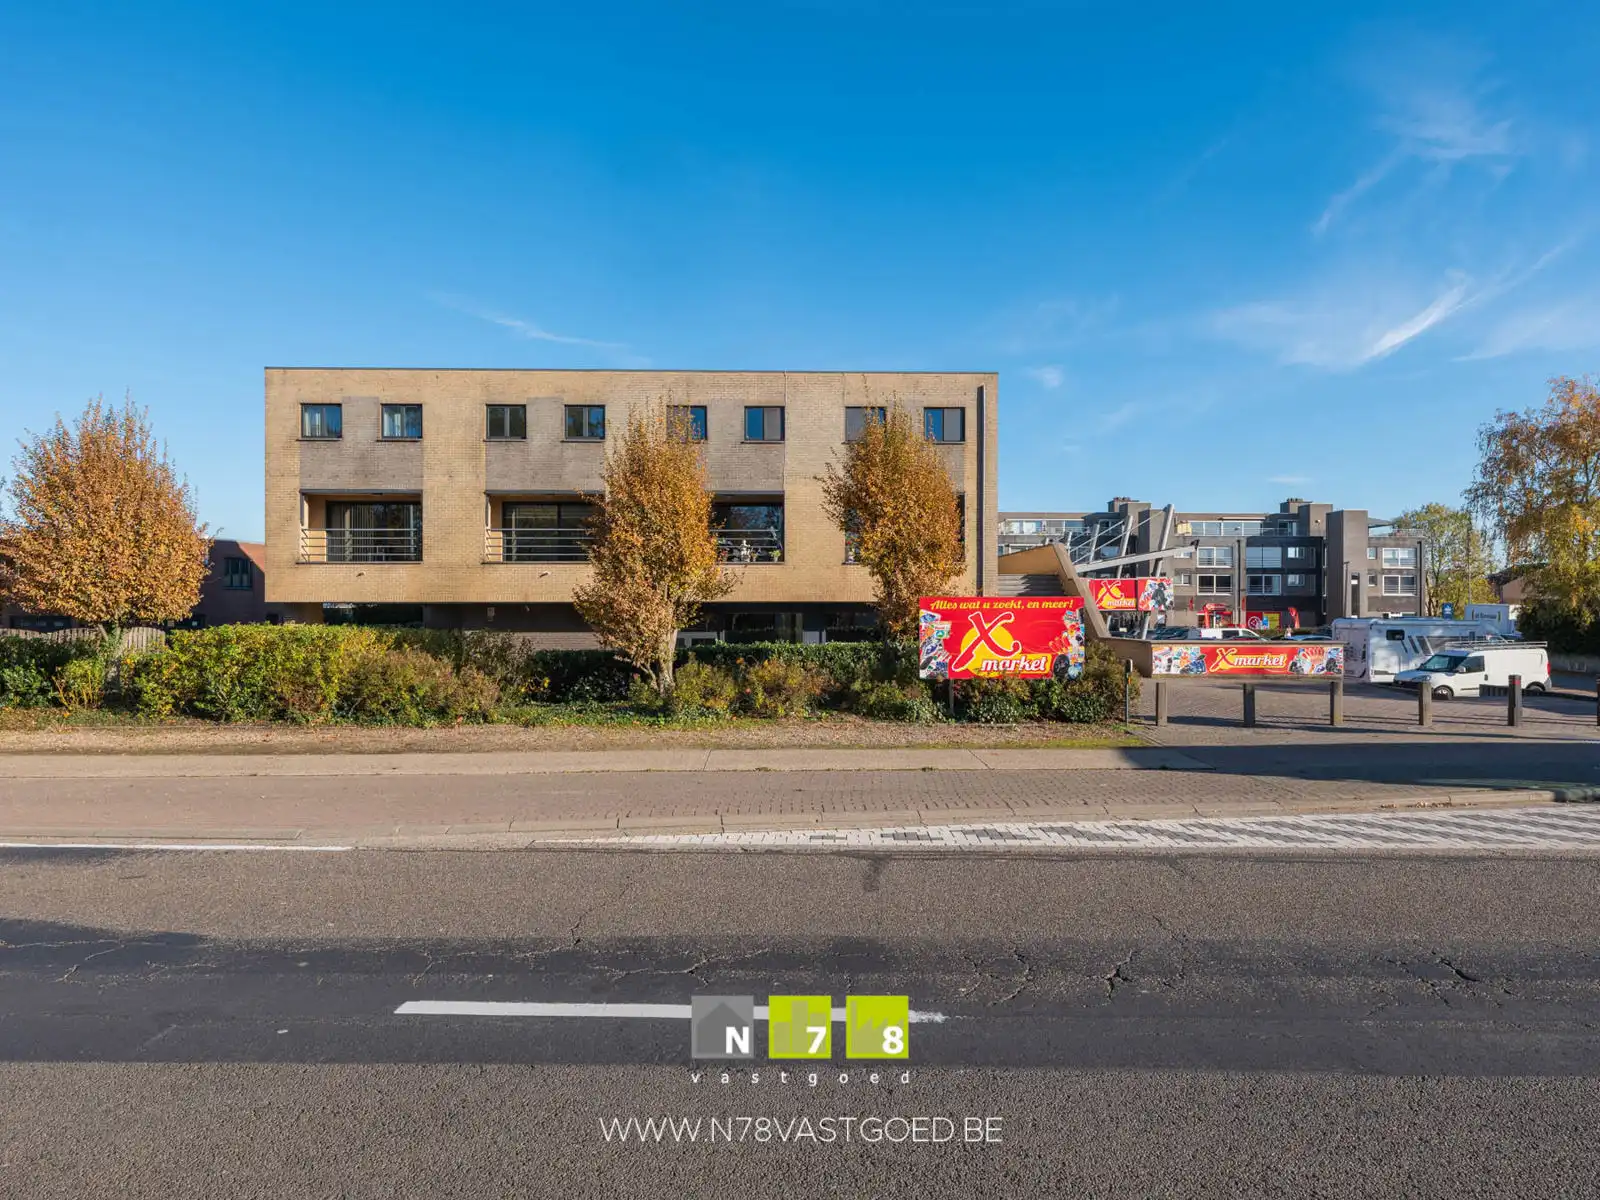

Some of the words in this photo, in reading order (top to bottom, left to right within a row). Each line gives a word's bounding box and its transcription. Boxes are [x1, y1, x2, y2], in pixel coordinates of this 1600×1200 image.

[930, 600, 957, 610] Alles
[959, 601, 980, 609] wat
[993, 600, 1024, 609] zoekt,
[1041, 600, 1074, 609] meer!
[1107, 599, 1135, 607] market
[951, 611, 1022, 672] X
[980, 655, 1047, 671] market
